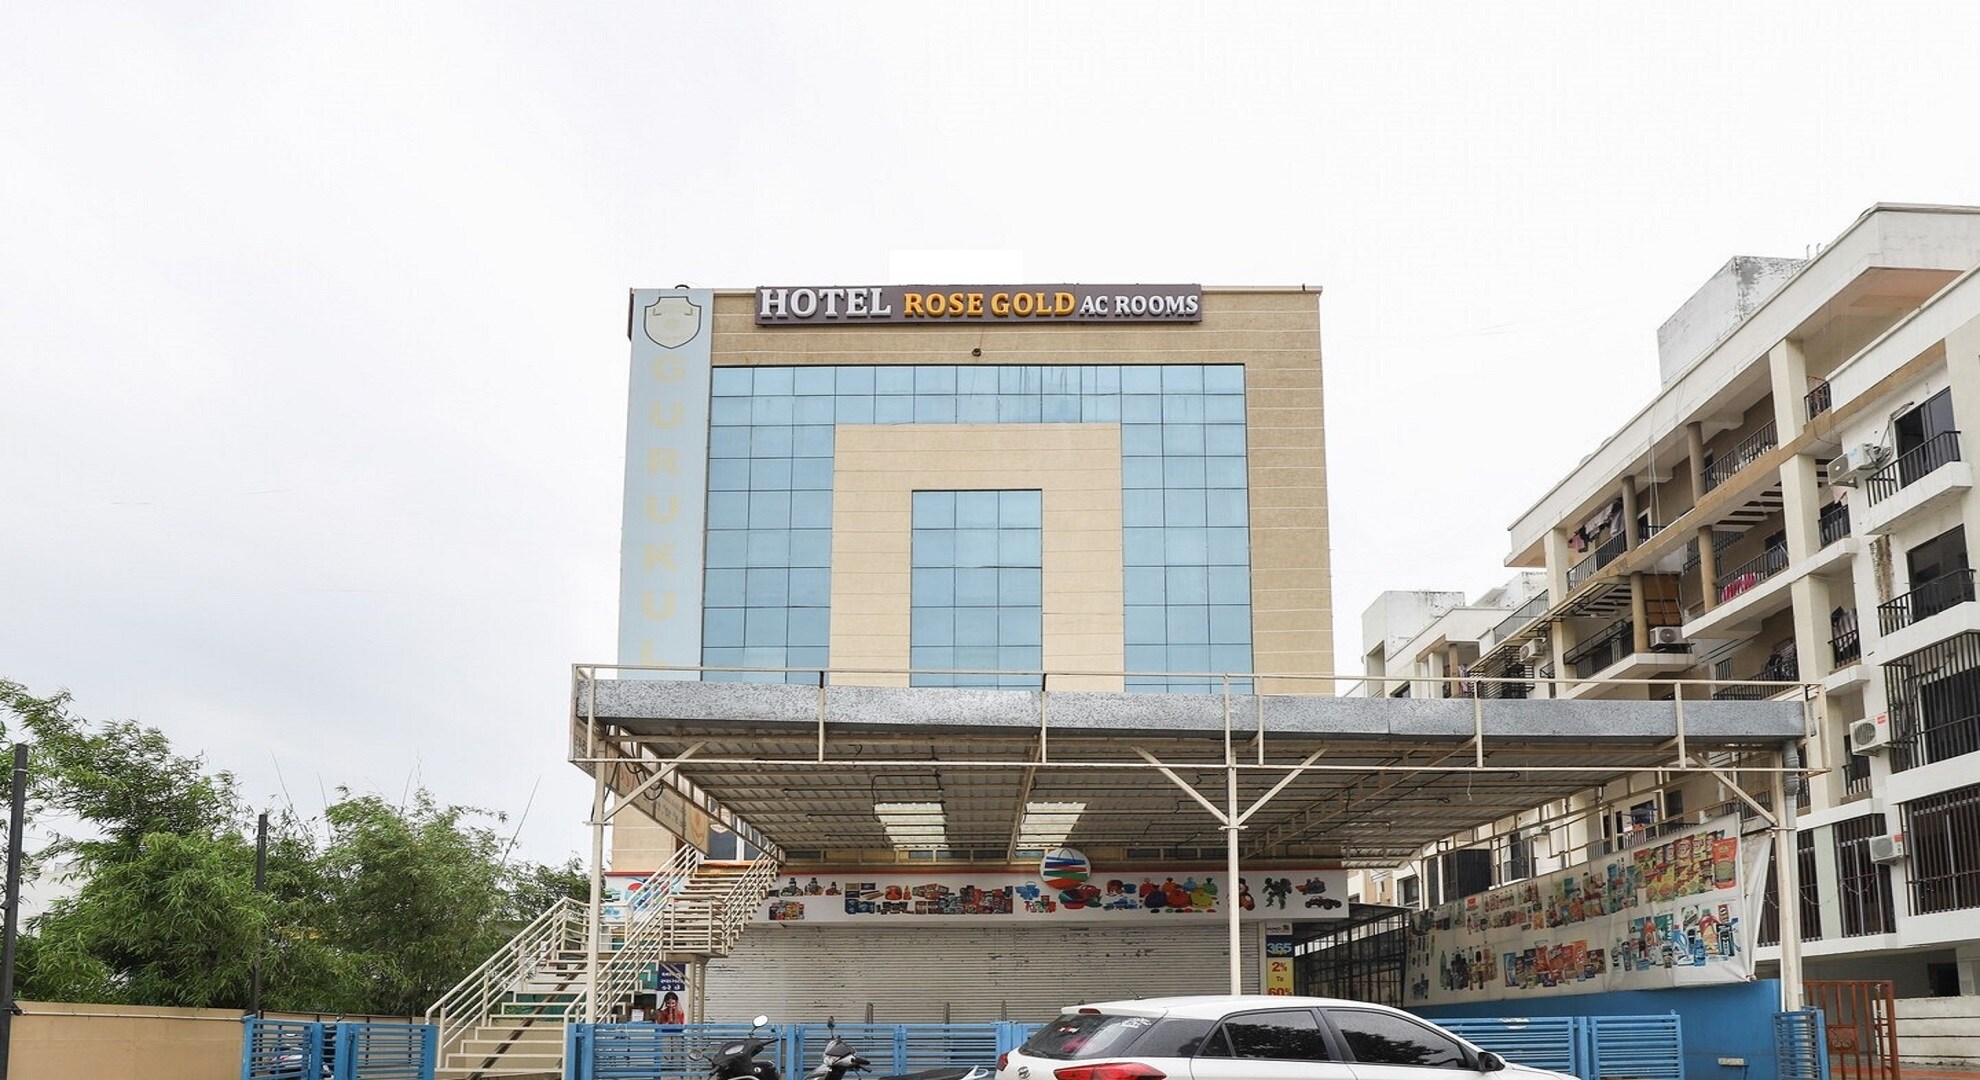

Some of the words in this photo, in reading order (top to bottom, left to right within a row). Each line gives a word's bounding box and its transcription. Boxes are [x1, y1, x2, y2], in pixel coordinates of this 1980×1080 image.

[760, 288, 892, 318] HOTEL
[904, 292, 984, 317] ROSE
[991, 291, 1076, 317] GOLD
[1080, 295, 1109, 317] AC
[1115, 295, 1199, 317] ROOMS
[640, 353, 688, 666] GURUKUL
[1267, 942, 1292, 955] 365
[1271, 961, 1288, 973] 2%
